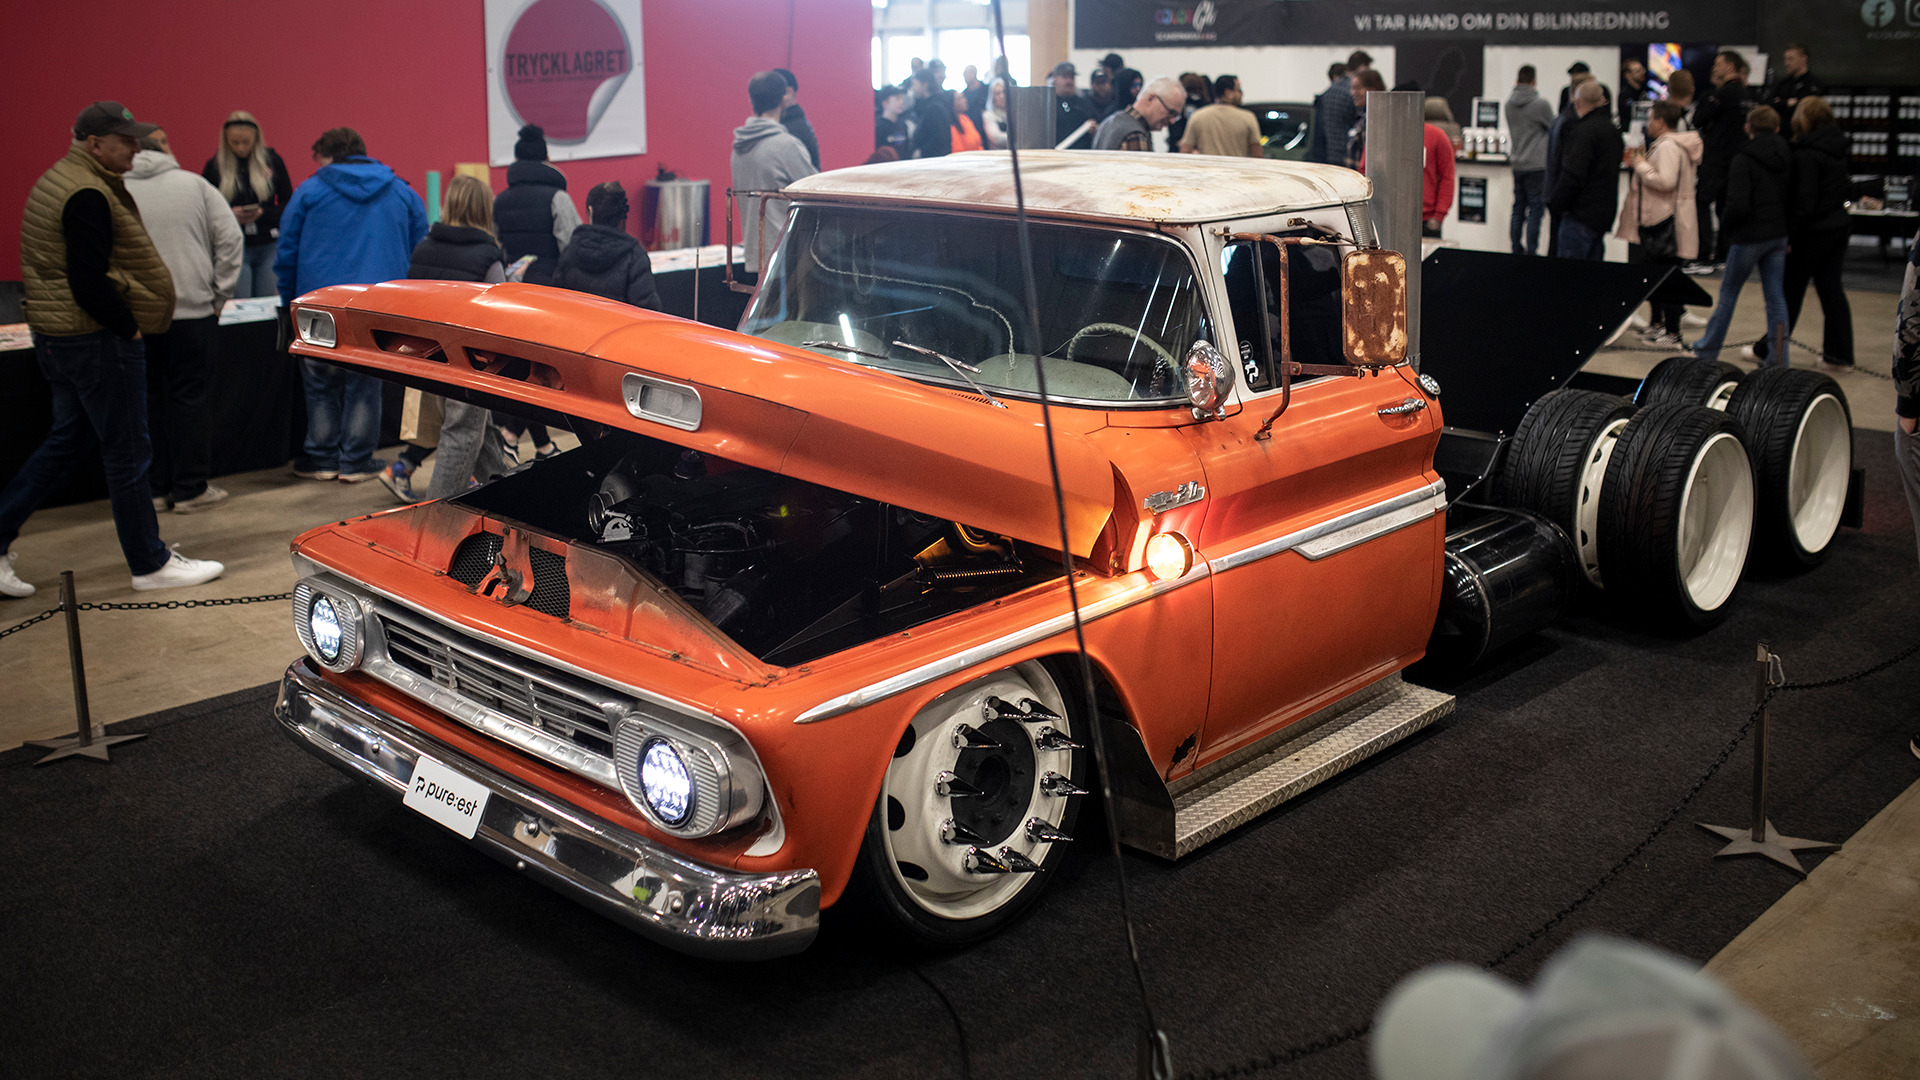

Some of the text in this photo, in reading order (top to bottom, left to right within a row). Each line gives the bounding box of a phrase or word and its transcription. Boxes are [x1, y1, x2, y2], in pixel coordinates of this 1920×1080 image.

[1354, 11, 1670, 31] VI TAR HAND OM DIN BILINREDNING
[506, 49, 624, 77] TRYCKLAGRET
[425, 781, 478, 817] pure:est
